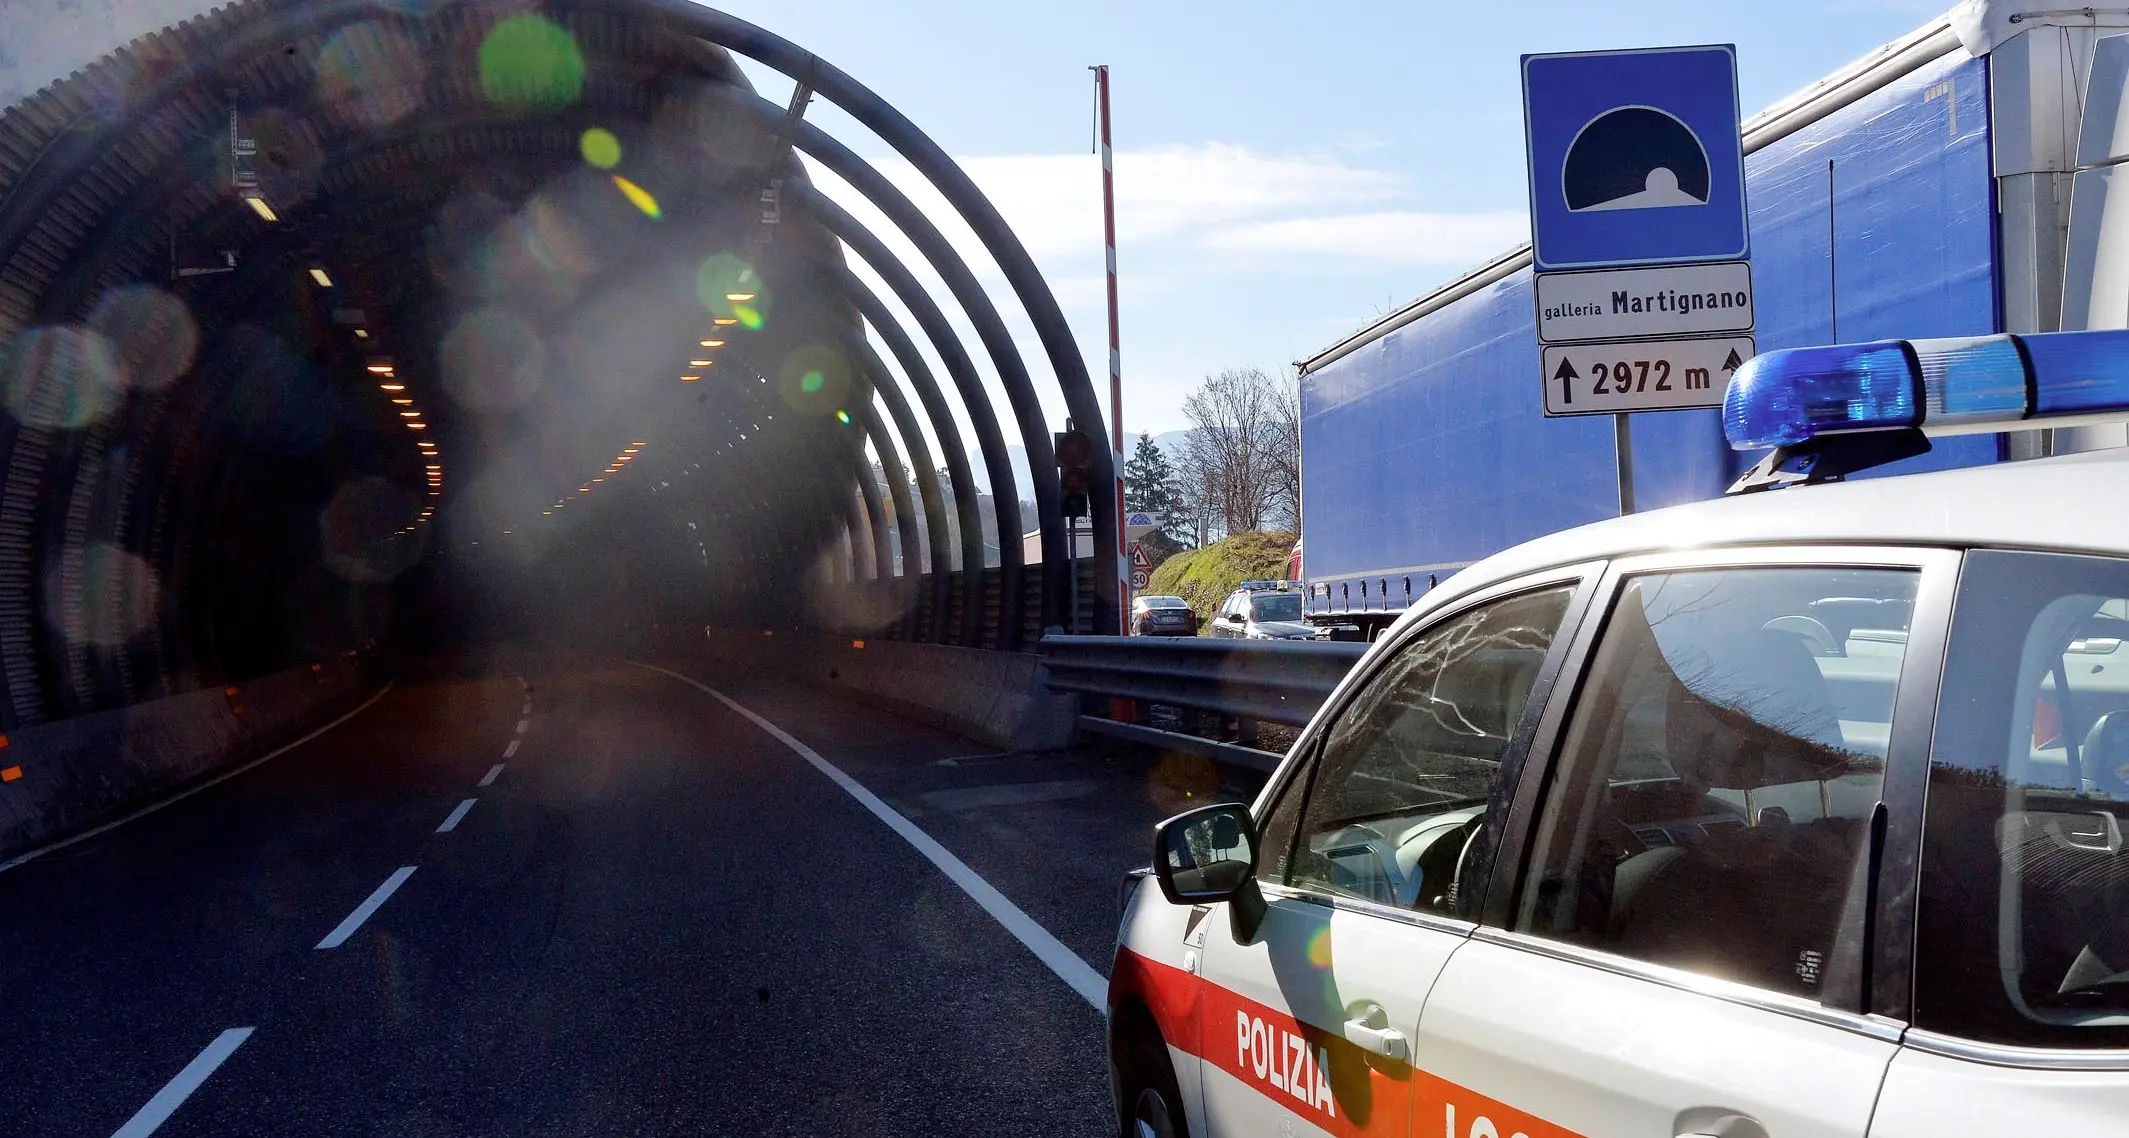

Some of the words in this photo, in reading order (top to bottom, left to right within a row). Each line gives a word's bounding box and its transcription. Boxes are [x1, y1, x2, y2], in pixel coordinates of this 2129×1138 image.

[1545, 303, 1602, 320] galleria
[1612, 290, 1747, 315] Martignano
[1592, 360, 1672, 395] 2972
[1685, 366, 1710, 390] m
[1132, 574, 1145, 584] 50
[1237, 1009, 1336, 1118] POLIZIA
